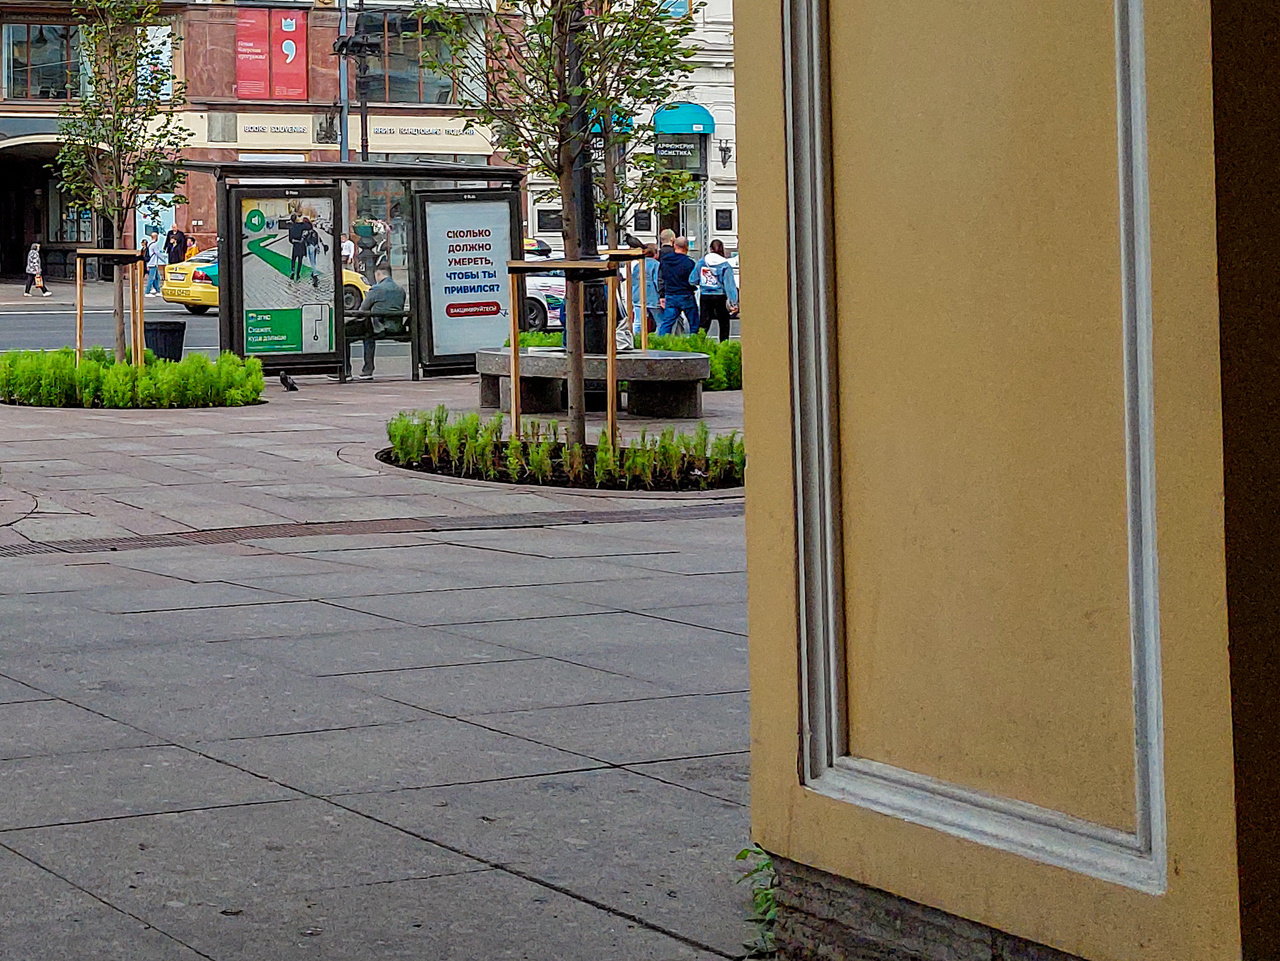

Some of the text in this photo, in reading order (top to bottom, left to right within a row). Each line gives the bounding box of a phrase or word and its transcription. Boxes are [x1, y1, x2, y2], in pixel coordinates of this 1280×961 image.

[244, 125, 268, 133] BOOKS
[446, 229, 491, 239] СКОЛЬКО
[447, 243, 492, 254] ДОЛЖНО
[447, 257, 494, 267] УМЕРЕТЬ,
[445, 270, 497, 281] ЧТОБЫ ТЫ
[444, 284, 500, 295] ПРИВИЛСЯ?
